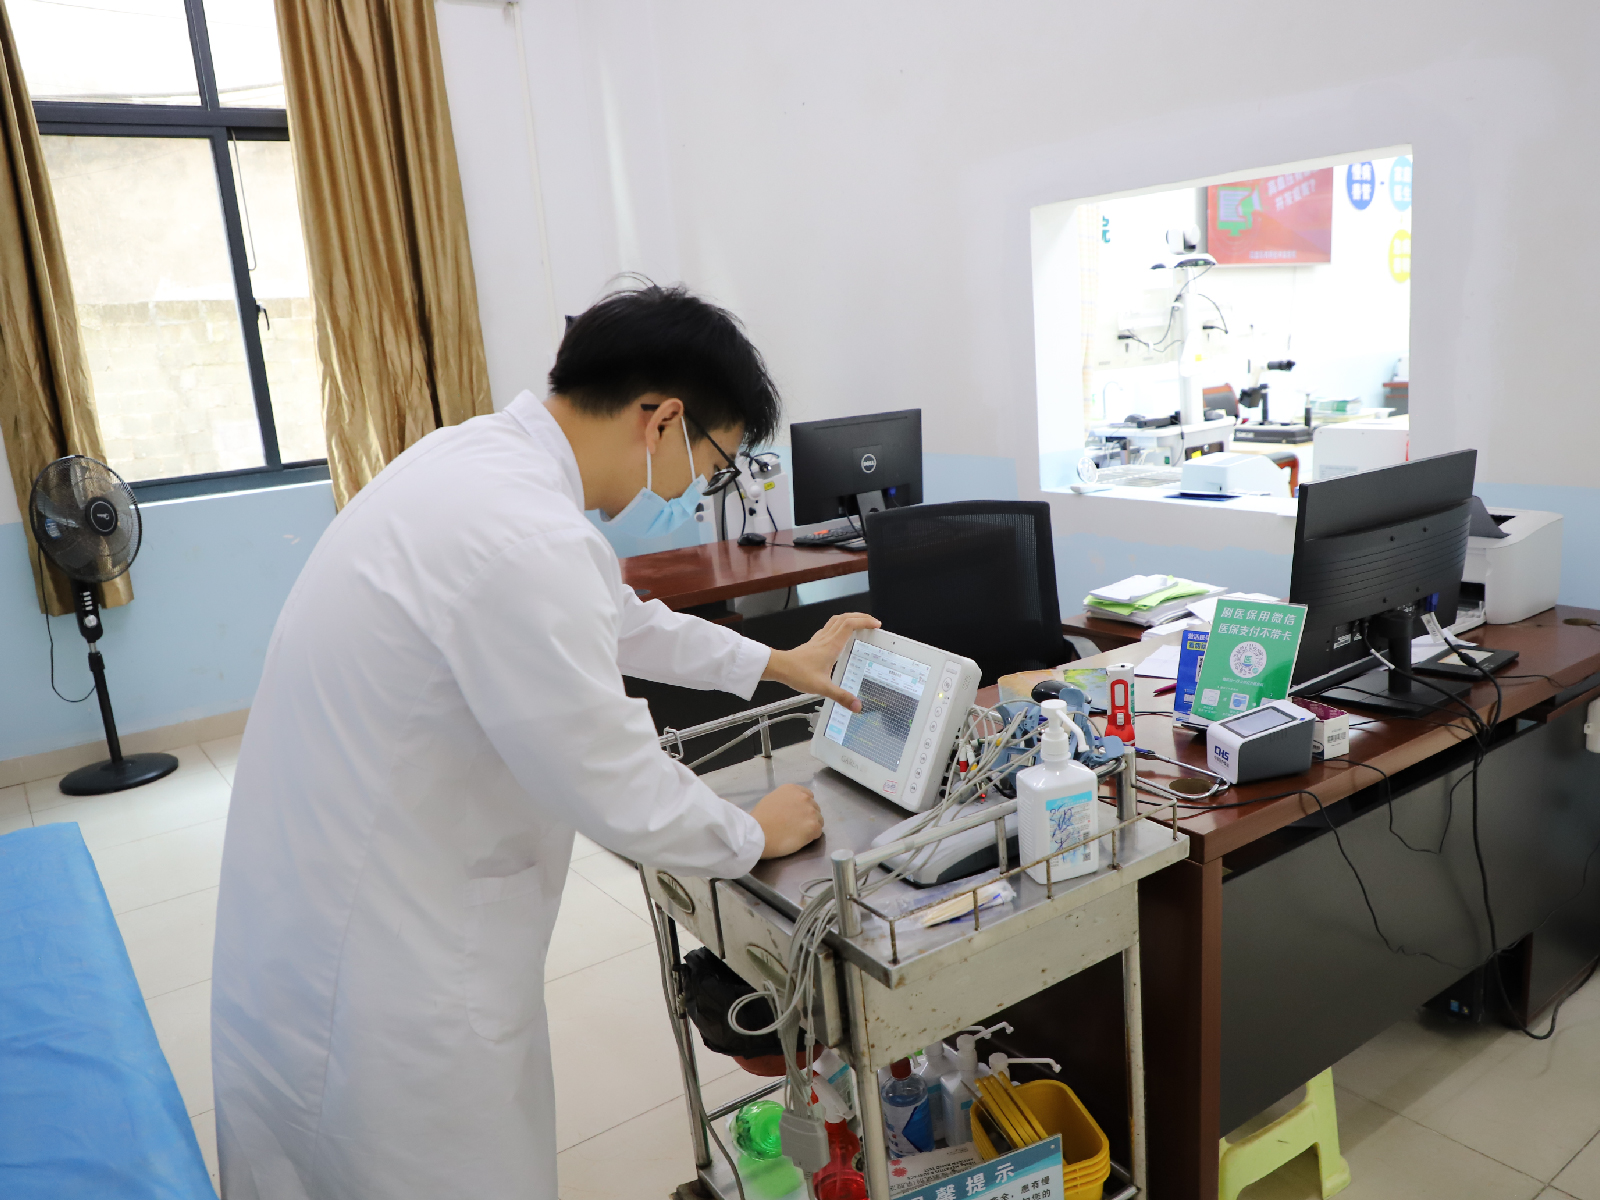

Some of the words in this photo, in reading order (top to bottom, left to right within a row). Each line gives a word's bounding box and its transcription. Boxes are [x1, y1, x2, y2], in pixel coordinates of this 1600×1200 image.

[1220, 607, 1297, 625] 刷医保用微信
[1218, 623, 1292, 640] 医保支付不带卡
[911, 1162, 1015, 1200] 馨提示
